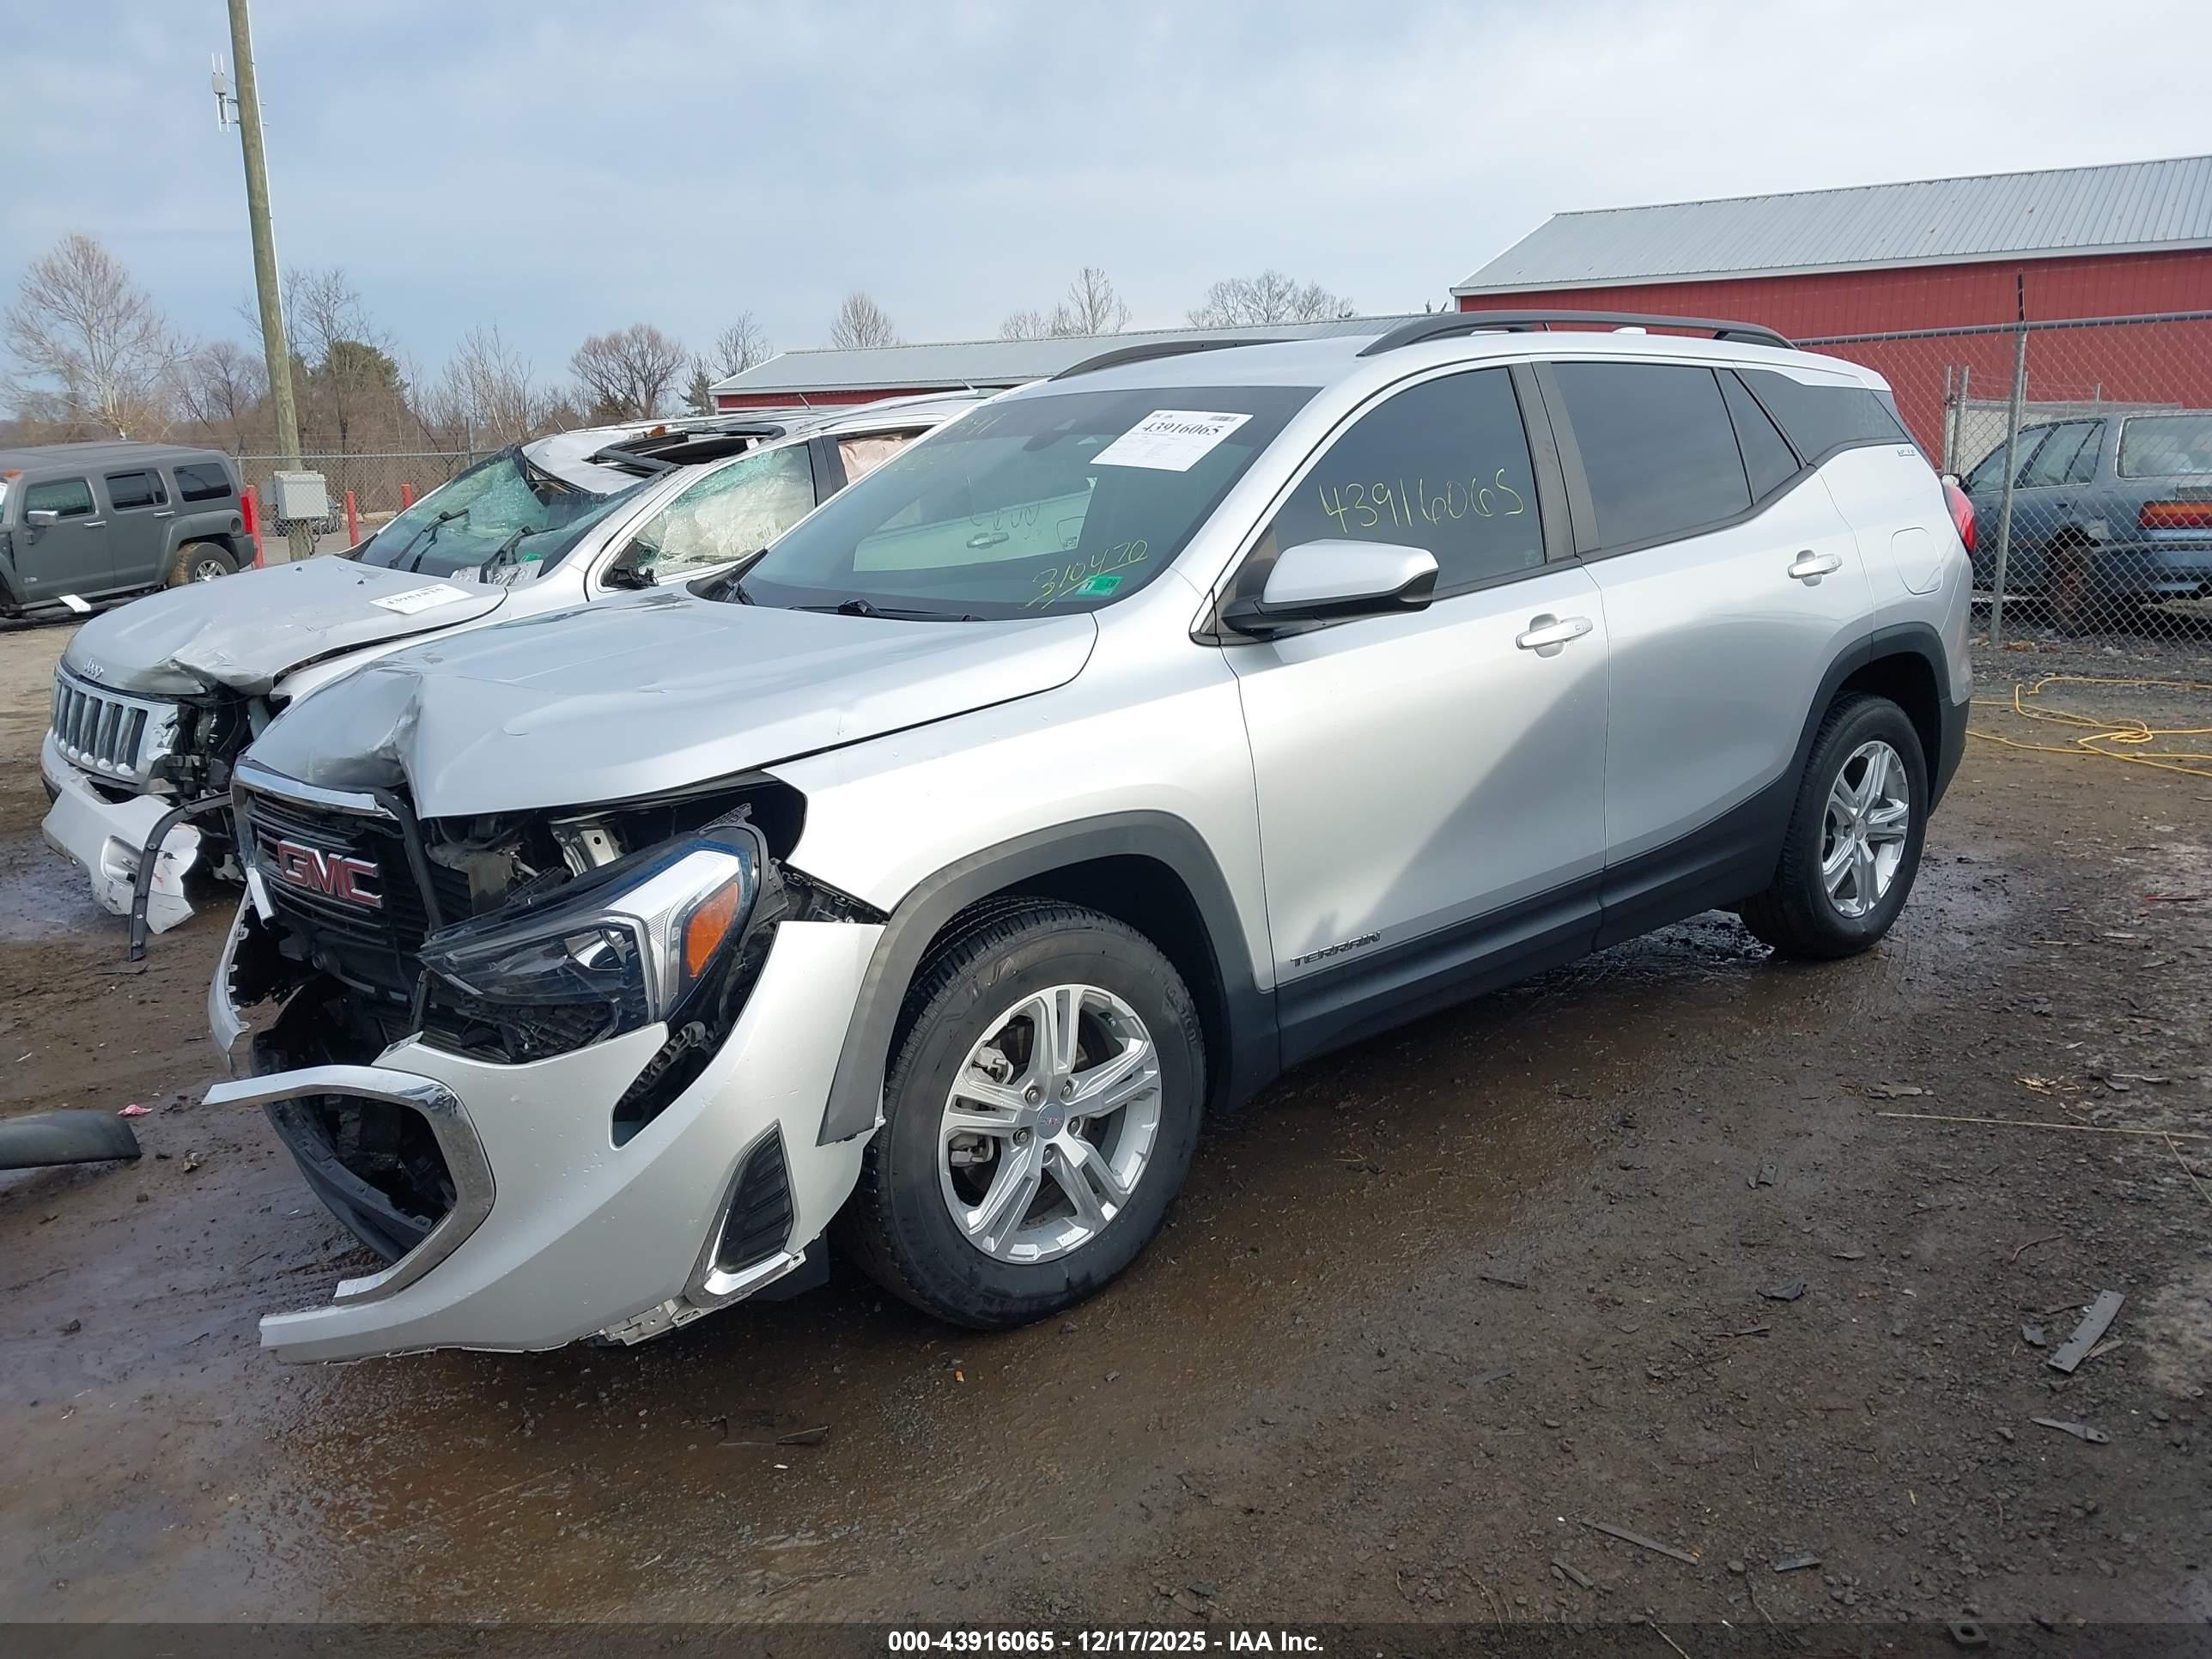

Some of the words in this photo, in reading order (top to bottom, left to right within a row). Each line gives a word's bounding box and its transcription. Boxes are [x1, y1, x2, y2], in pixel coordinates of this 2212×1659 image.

[1141, 422, 1225, 436] 43916065
[1319, 468, 1525, 533] 43916065
[278, 839, 384, 909] GMC
[1290, 929, 1382, 968] TERRAIN
